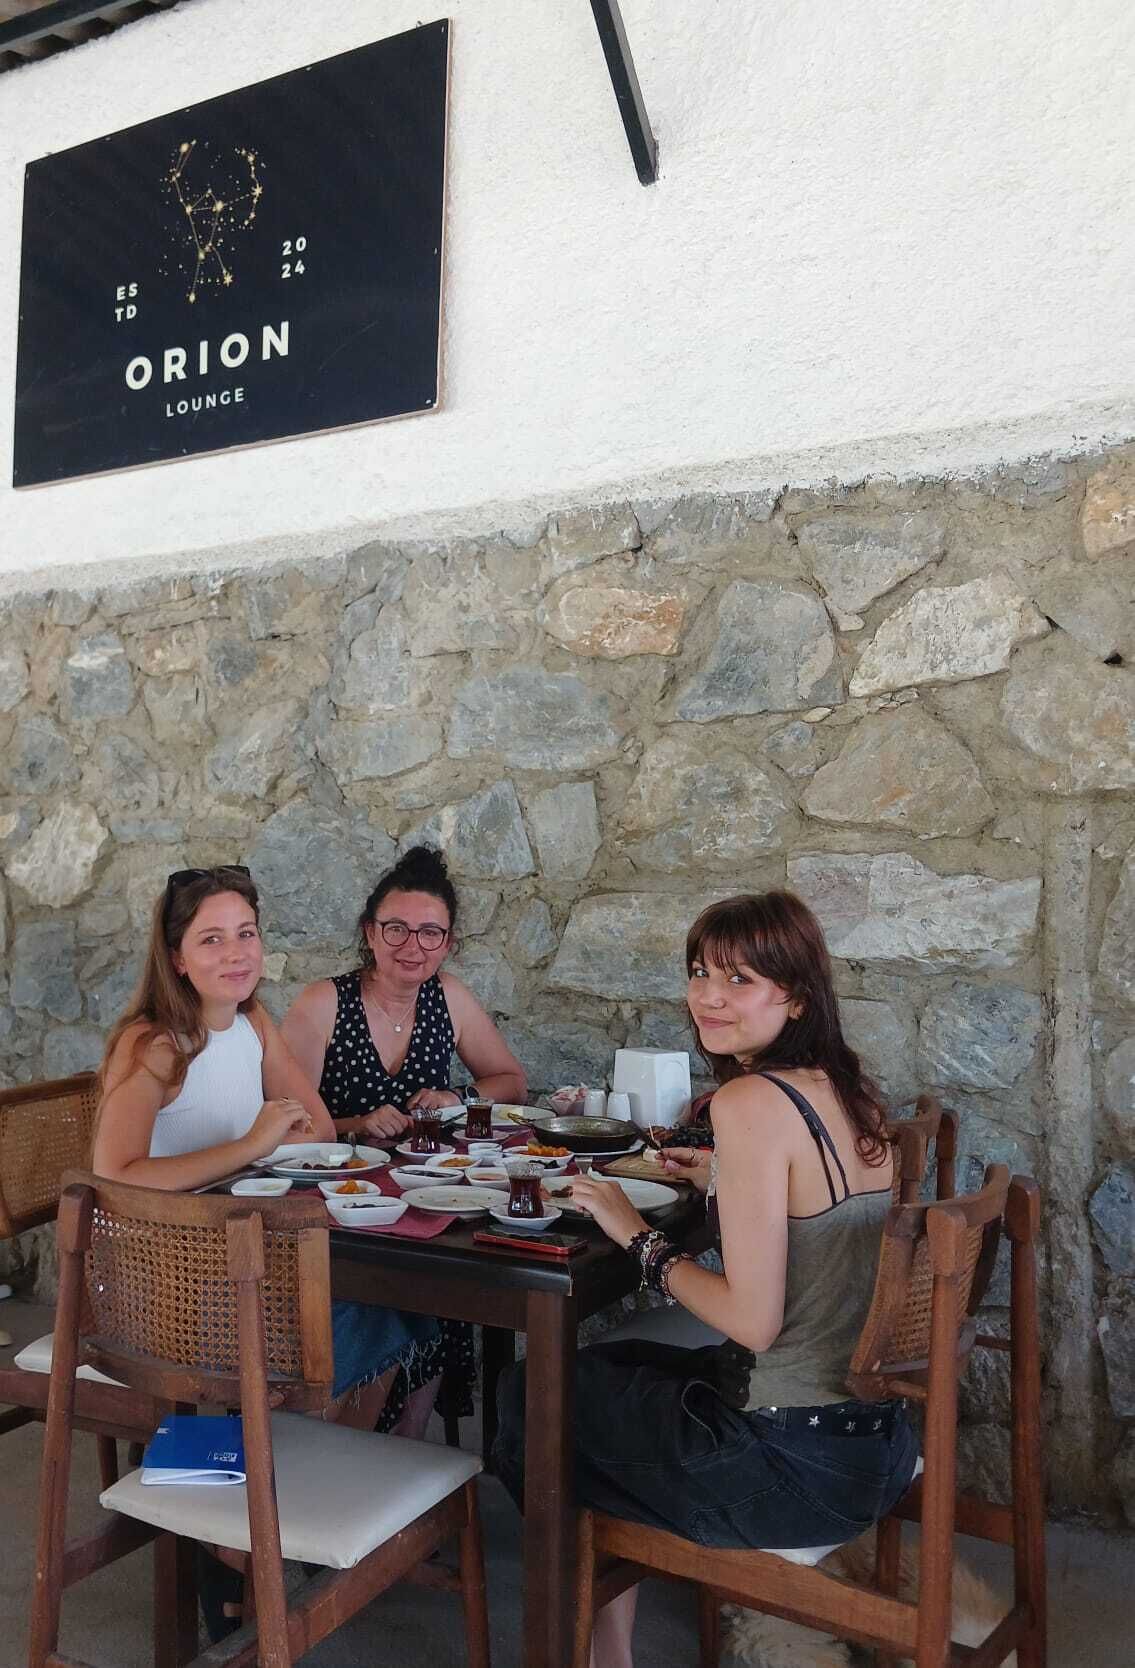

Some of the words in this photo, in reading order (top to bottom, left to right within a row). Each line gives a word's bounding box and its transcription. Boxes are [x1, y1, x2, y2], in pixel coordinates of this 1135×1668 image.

[282, 236, 307, 256] 20
[281, 259, 306, 279] 24
[116, 282, 138, 301] ES
[114, 304, 137, 322] TD
[125, 320, 289, 390] ORION
[166, 387, 245, 418] LOUNGE
